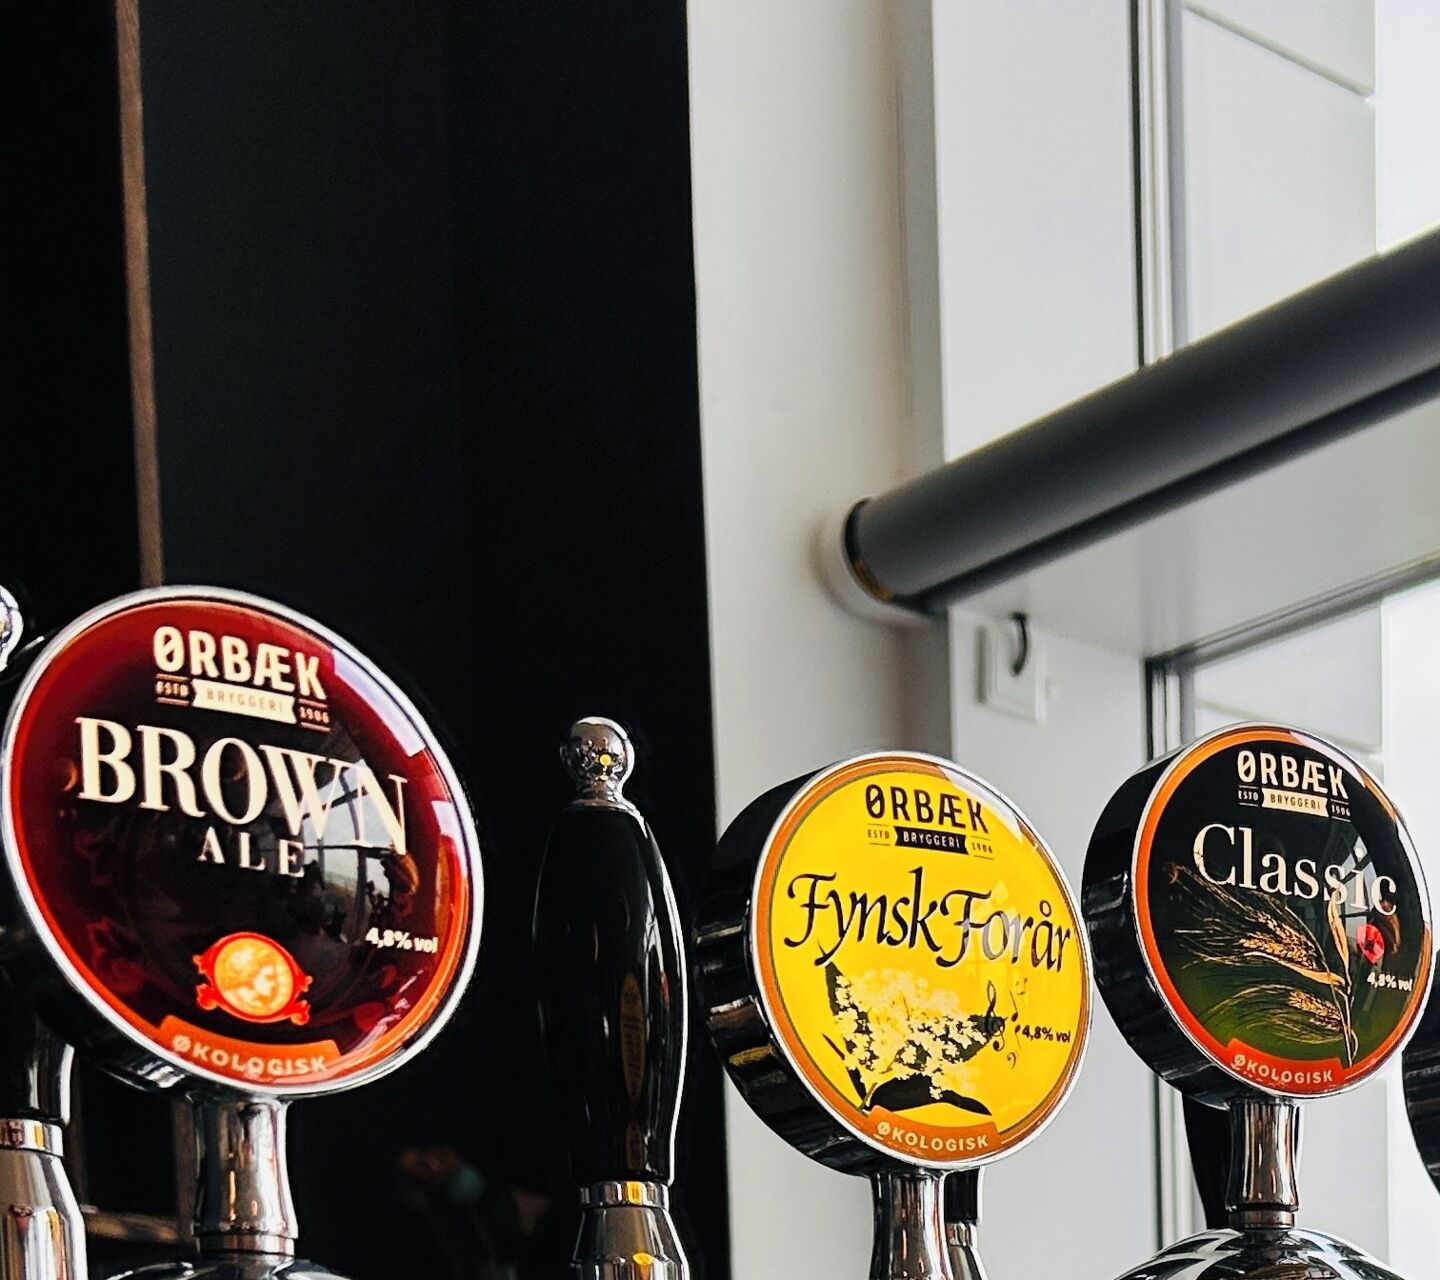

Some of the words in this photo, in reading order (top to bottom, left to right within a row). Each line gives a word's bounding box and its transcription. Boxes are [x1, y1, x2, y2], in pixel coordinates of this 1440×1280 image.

[153, 626, 327, 700] ØRBÆK
[207, 687, 285, 713] BRYGGERI
[74, 717, 409, 855] BROWN
[1237, 750, 1349, 799] ØRBÆK
[865, 784, 989, 834] ØRBÆK
[1270, 794, 1321, 811] BRYGGERI
[196, 826, 305, 878] ALE
[867, 829, 890, 839] ESTD
[903, 831, 960, 848] BRYGGERI
[1192, 823, 1397, 916] Classic
[365, 927, 412, 949] 4,8%
[414, 937, 439, 953] vol
[1367, 971, 1397, 988] 4,8%
[1022, 1025, 1053, 1041] 4,8%
[1056, 1030, 1071, 1043] vol
[172, 1034, 328, 1076] ØKOLOGISK
[1233, 1054, 1333, 1084] ØKOLOGISK
[877, 1121, 989, 1152] ØKOLOGISK
